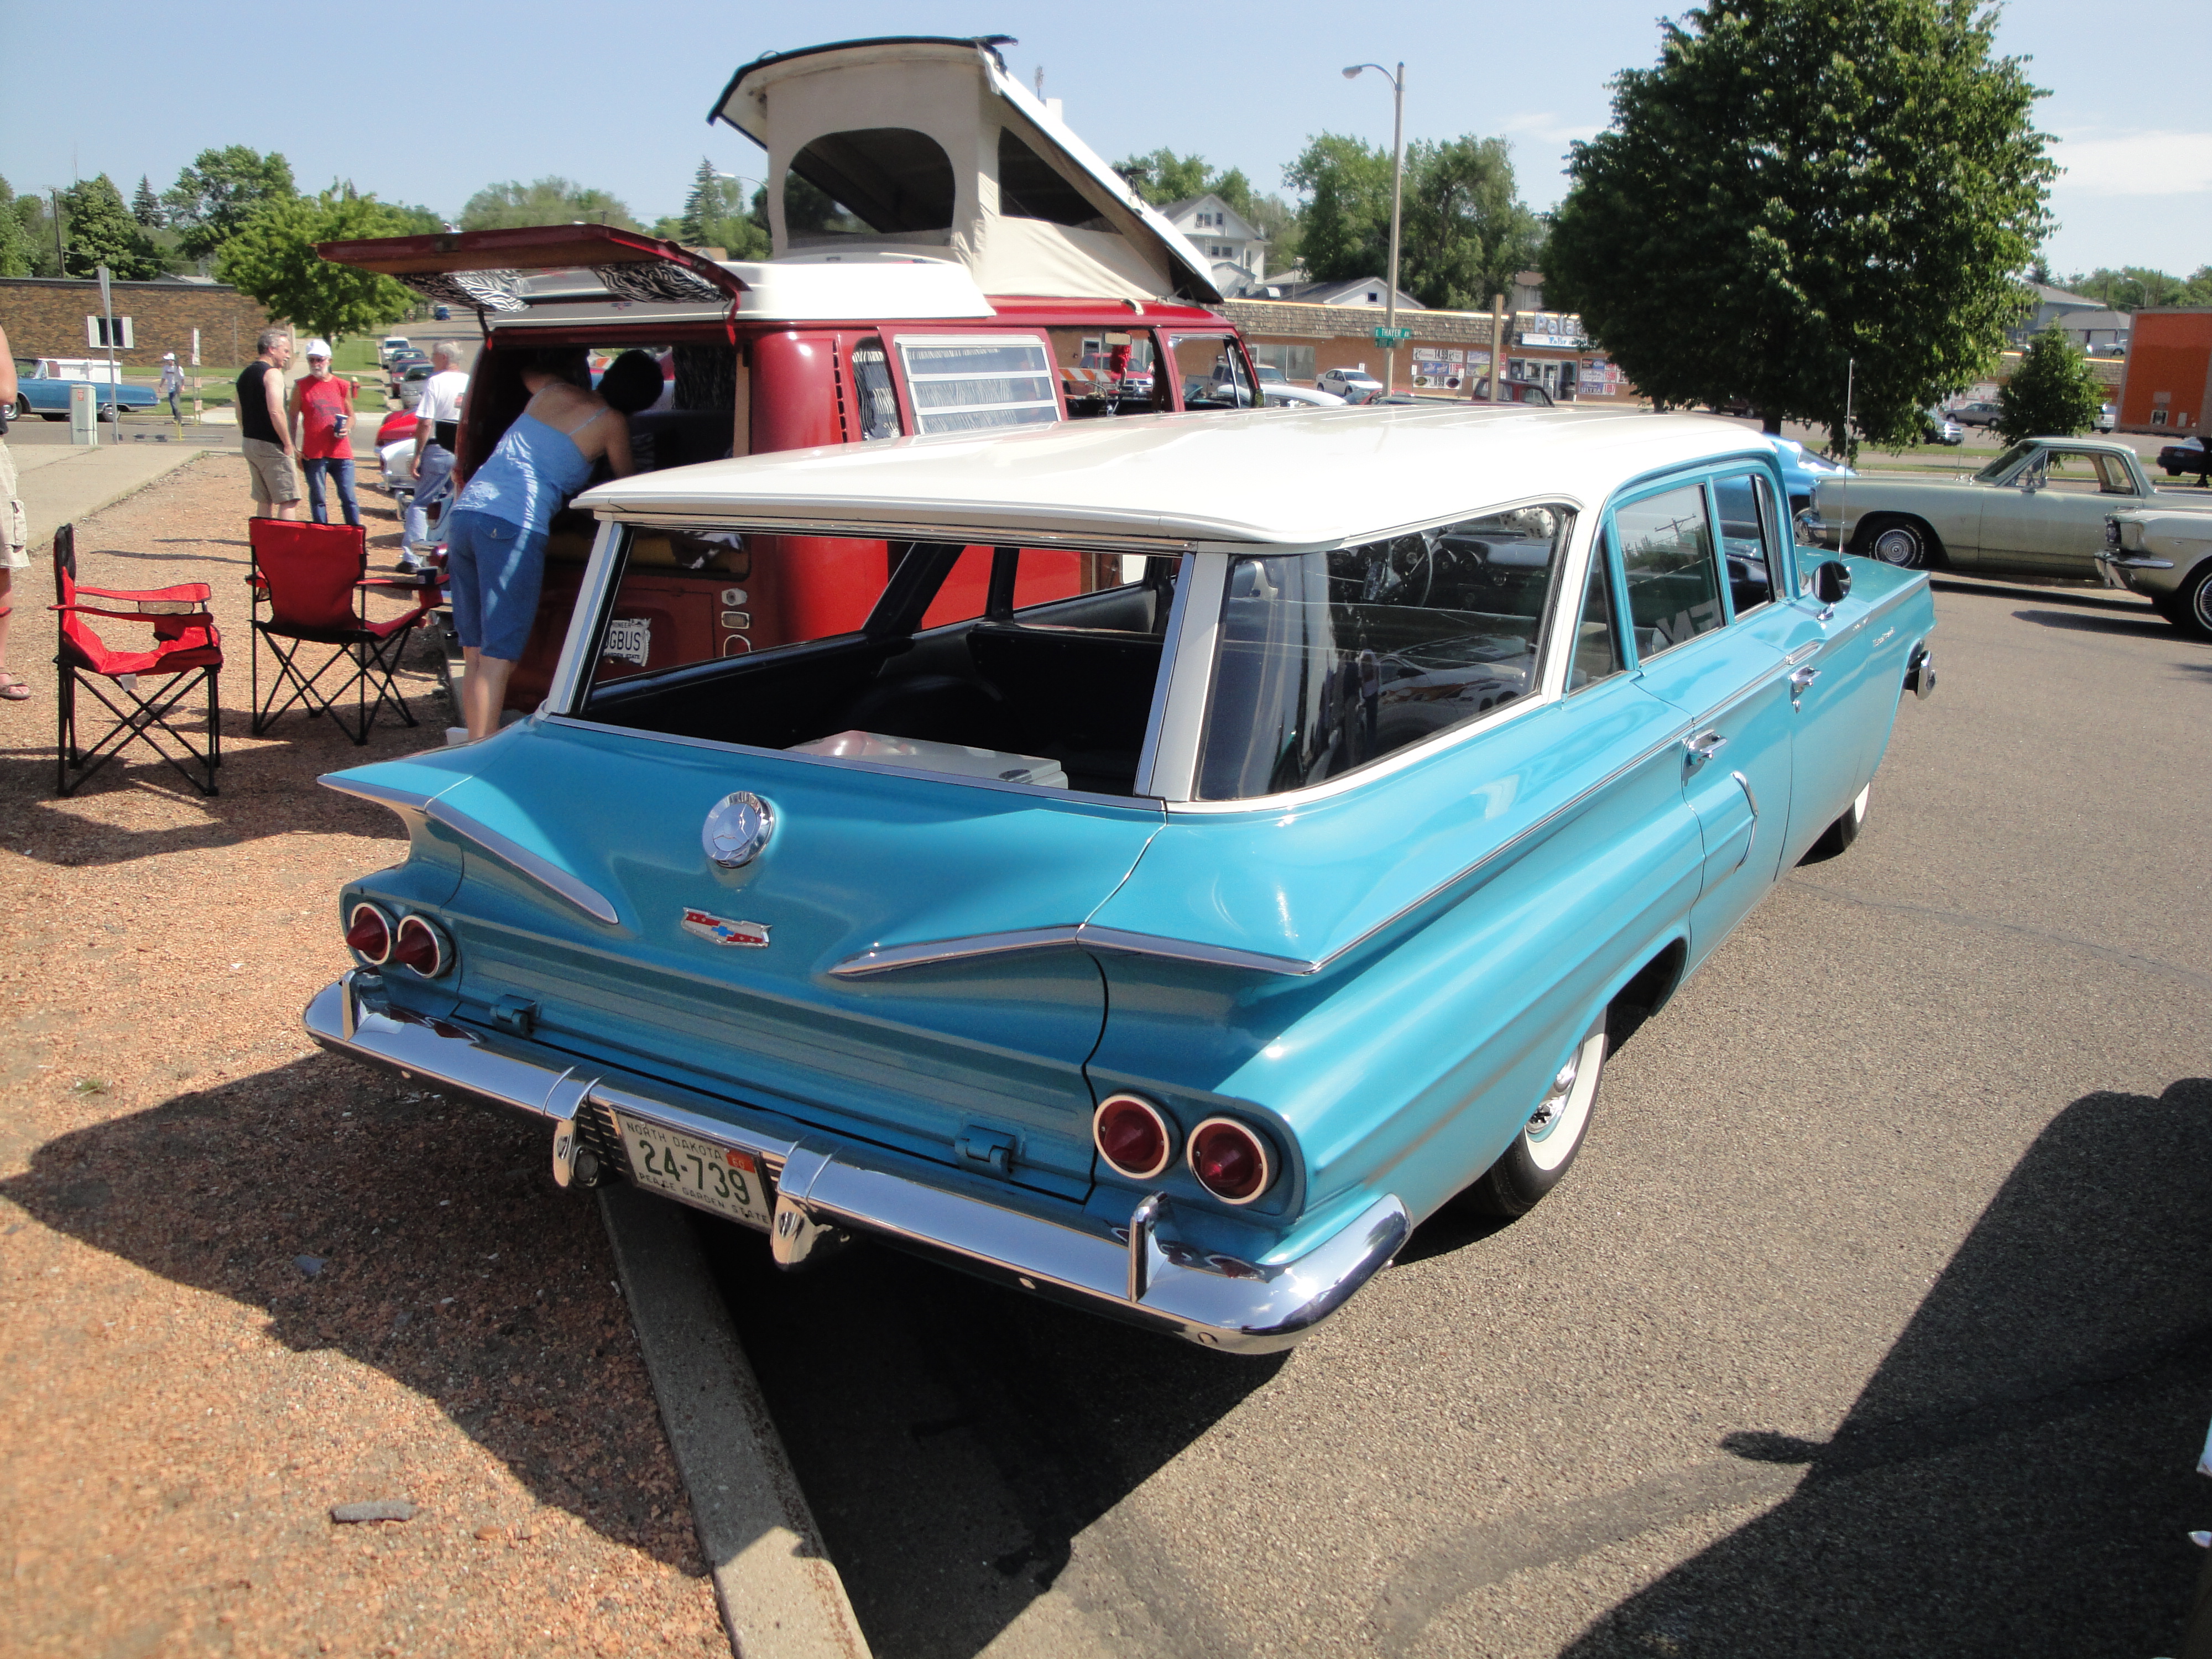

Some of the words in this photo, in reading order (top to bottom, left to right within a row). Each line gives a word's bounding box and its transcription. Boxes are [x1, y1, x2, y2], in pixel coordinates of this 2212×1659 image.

[1382, 328, 1401, 337] THAYER
[605, 630, 641, 651] GBUS
[626, 1120, 667, 1143] NORTH
[672, 1136, 723, 1161] DAKOTA
[639, 1139, 751, 1206] 24-739
[639, 1172, 676, 1191] PEACE
[682, 1187, 726, 1208] GARDEN
[731, 1204, 769, 1224] STATE
